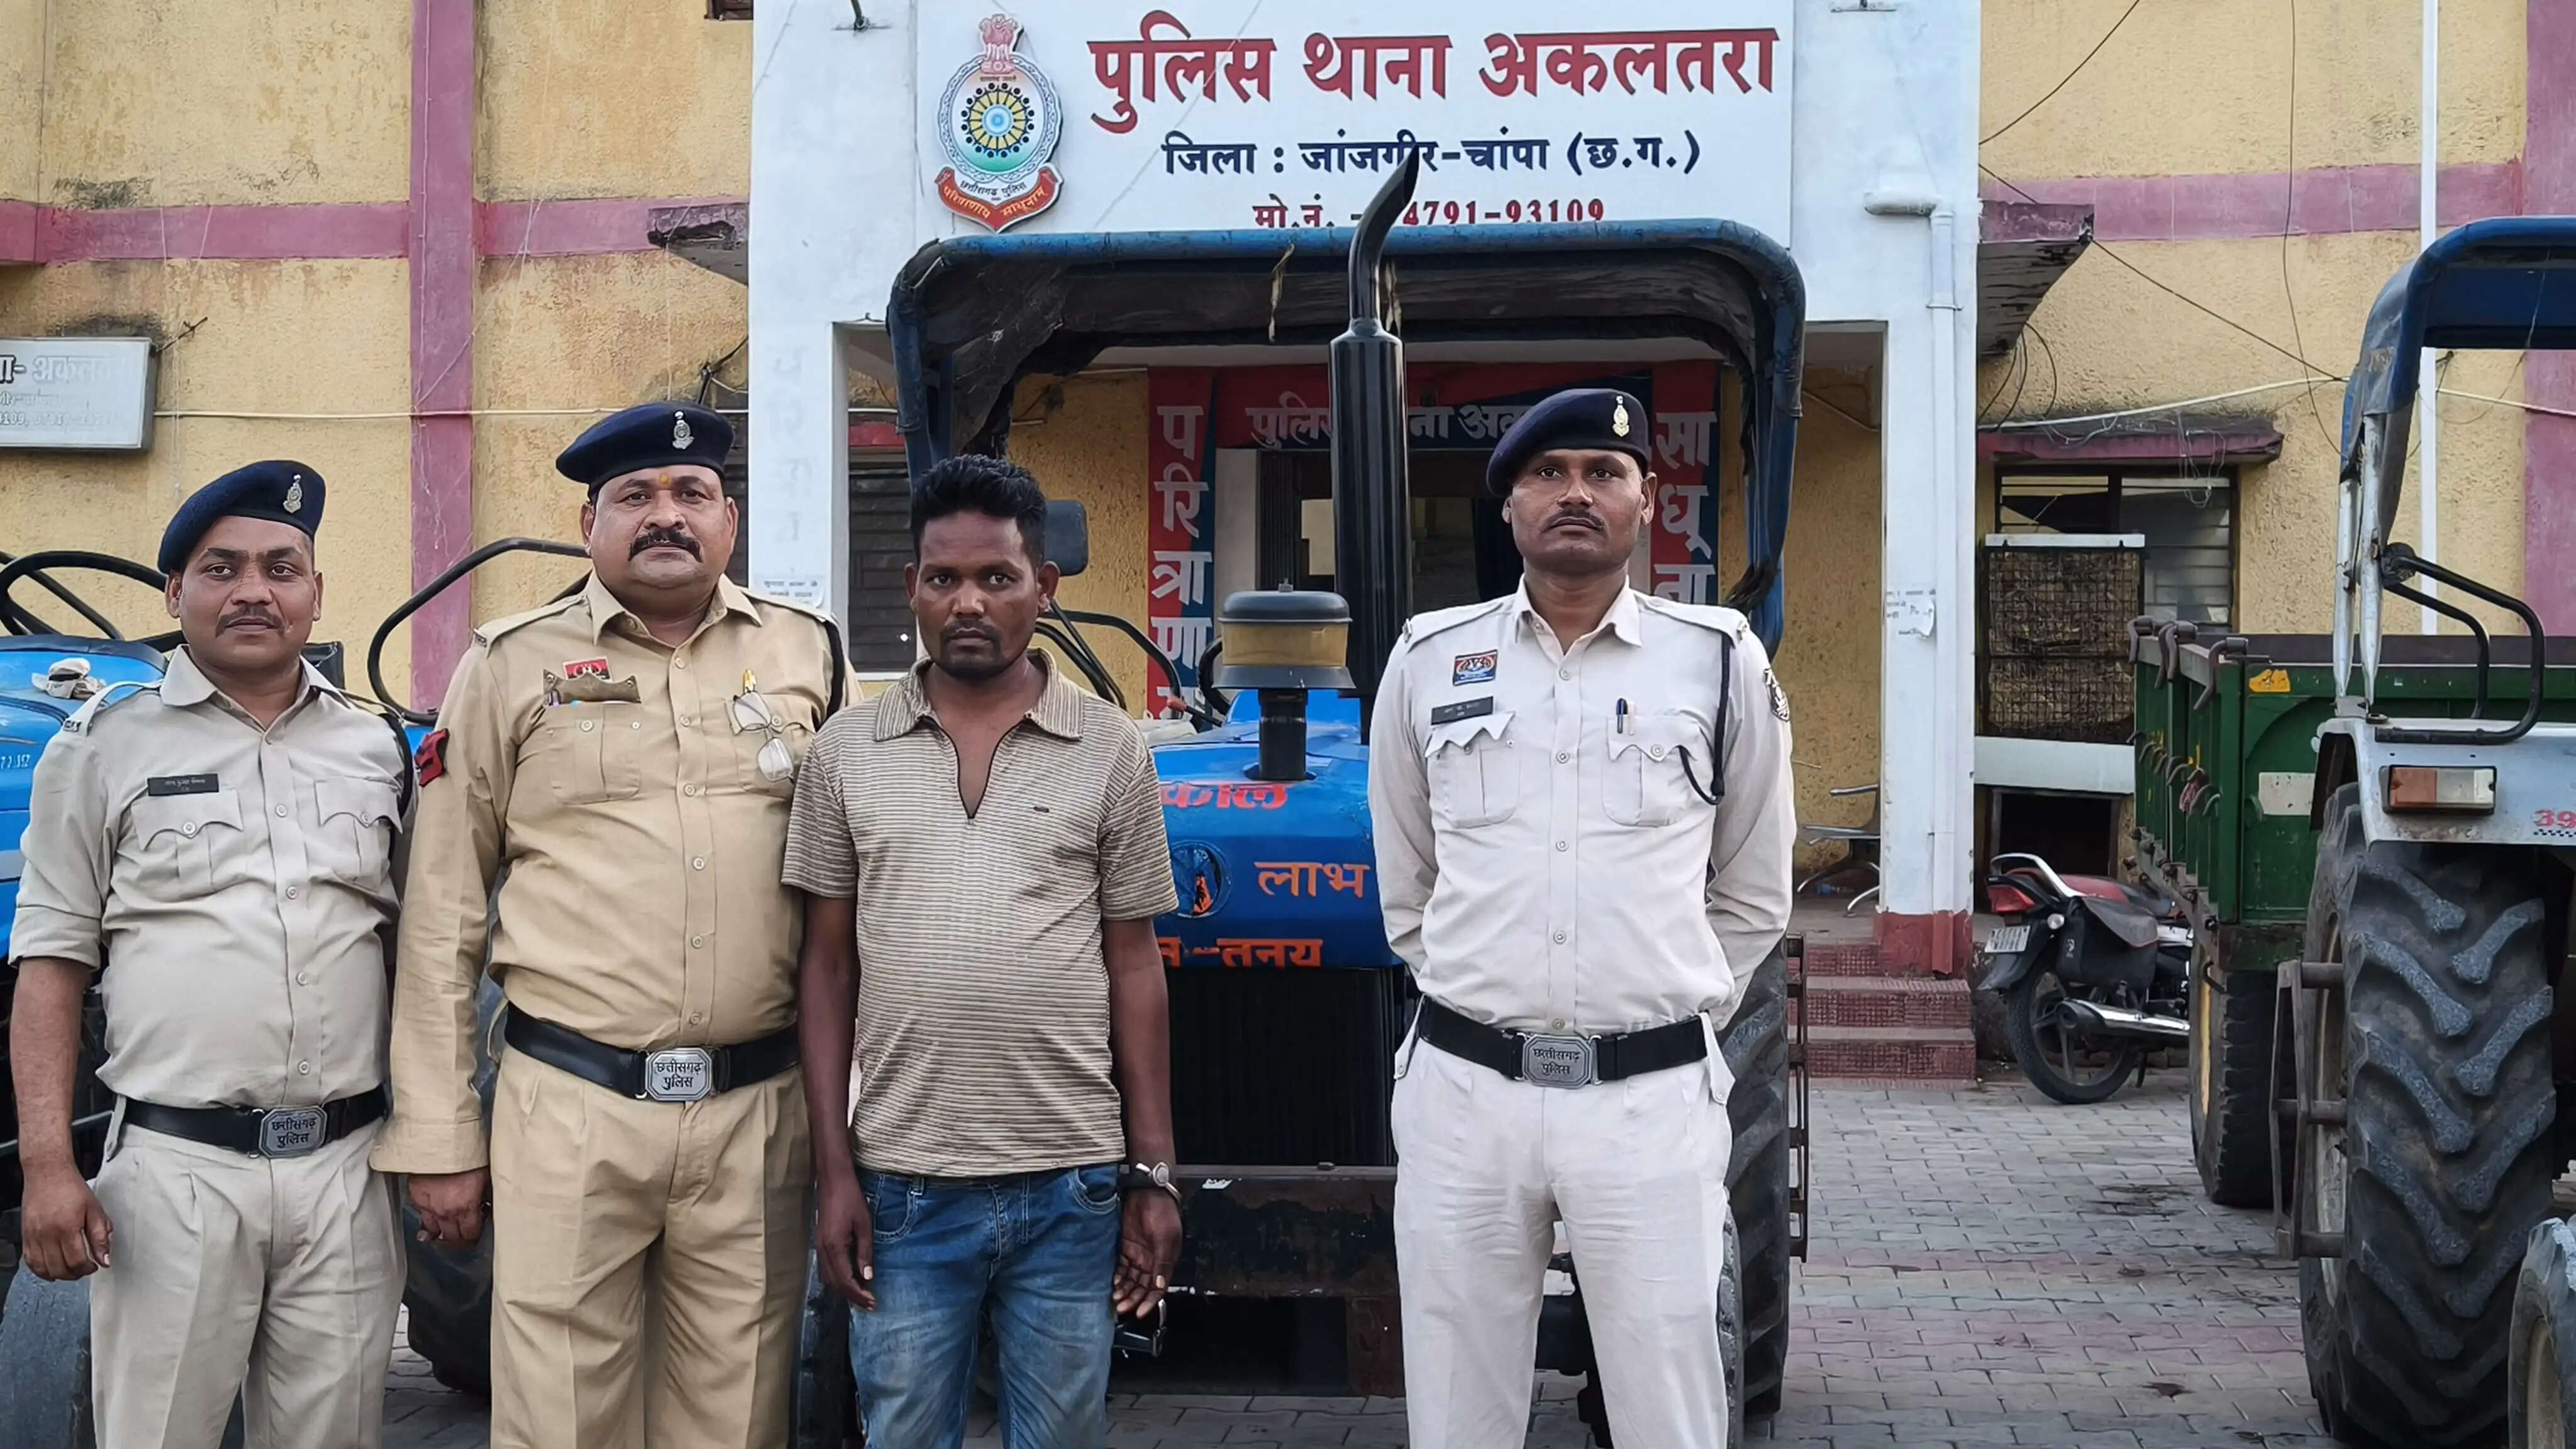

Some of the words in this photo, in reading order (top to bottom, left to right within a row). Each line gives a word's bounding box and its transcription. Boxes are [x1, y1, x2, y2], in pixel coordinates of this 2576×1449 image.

[1087, 10, 1277, 134] पुलिस
[1302, 33, 1453, 99] थाना
[1479, 28, 1780, 97] अकलतरा
[1161, 130, 1257, 174] जिला
[1567, 130, 1700, 175] (छ.ग.)
[1402, 199, 1604, 225] 4791-93109
[1159, 783, 1297, 809] काल
[1254, 862, 1370, 899] लाभ
[1157, 936, 1323, 969] न-तनय
[662, 1074, 694, 1091] पुलिस
[277, 1131, 310, 1148] पुलिस
